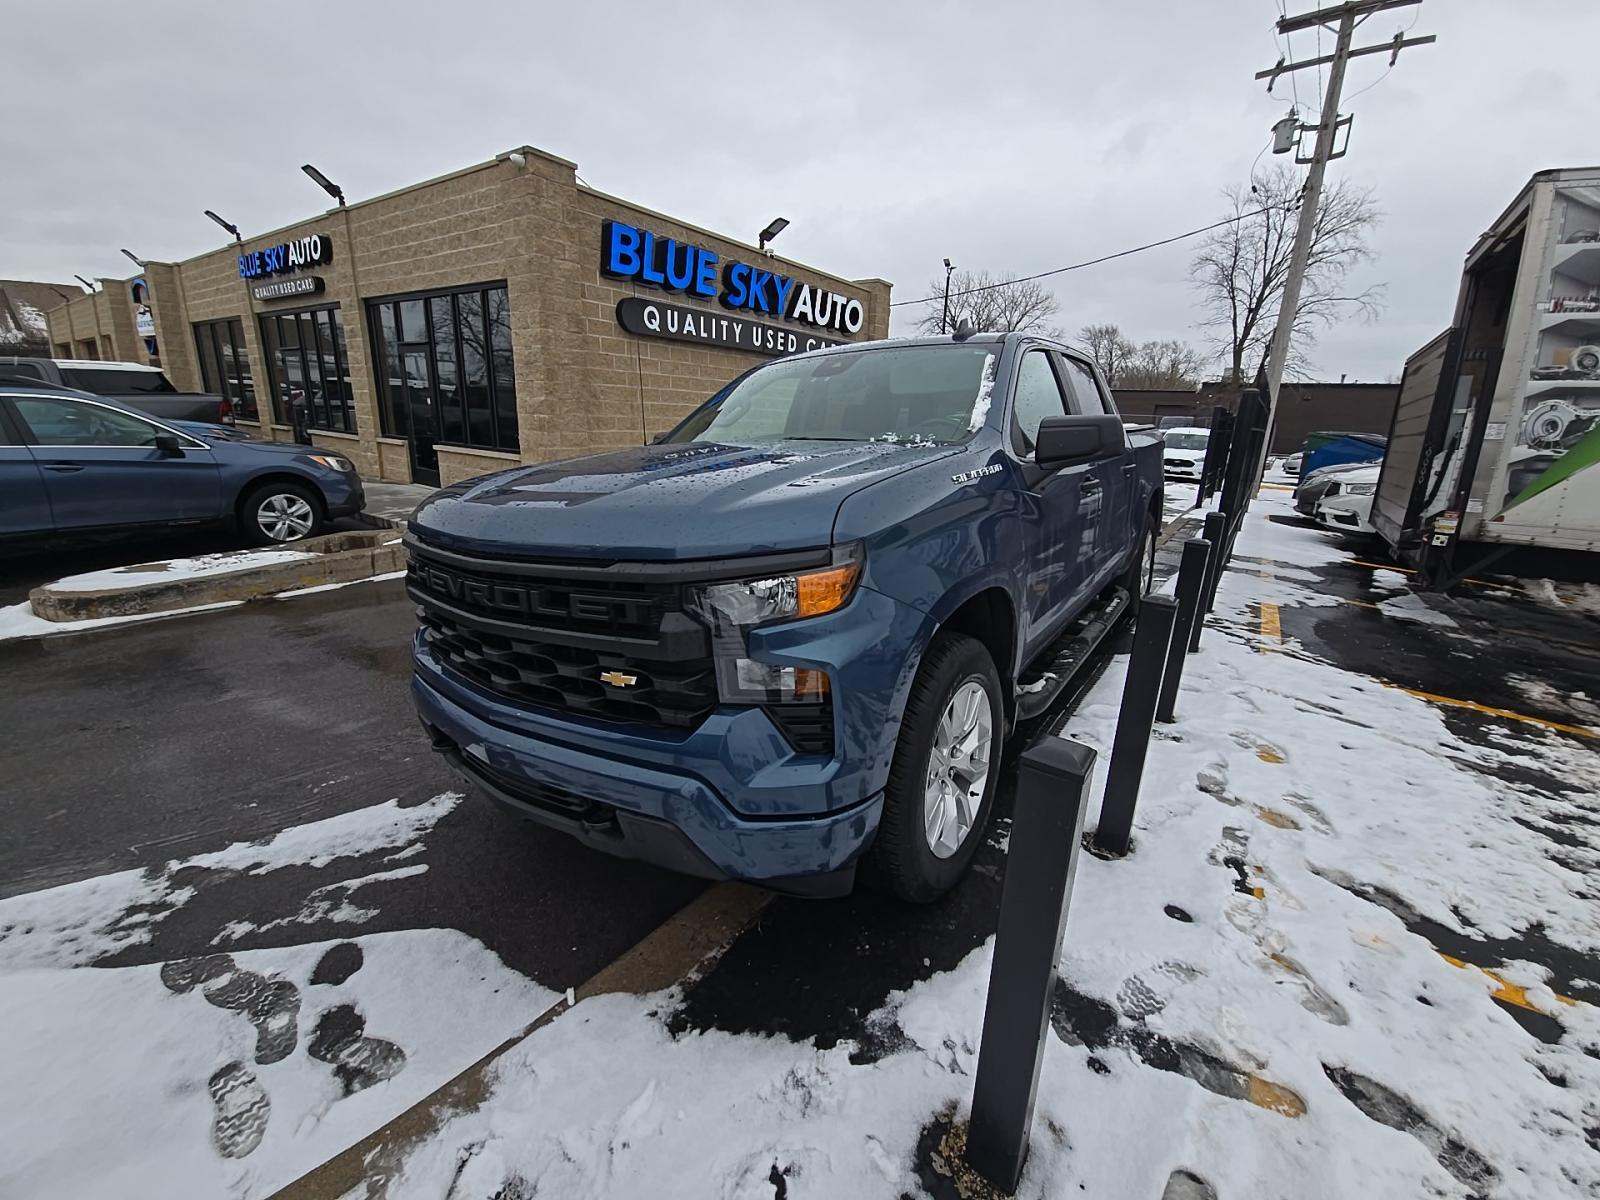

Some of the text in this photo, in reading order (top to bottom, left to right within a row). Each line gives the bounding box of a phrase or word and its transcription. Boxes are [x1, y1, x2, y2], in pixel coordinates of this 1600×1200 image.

[237, 234, 321, 277] BLUE SKY AUTO
[609, 221, 864, 333] BLUE SKY AUTO
[254, 278, 314, 299] QUALITY USED CARS
[643, 305, 841, 353] QUALITY USED CA
